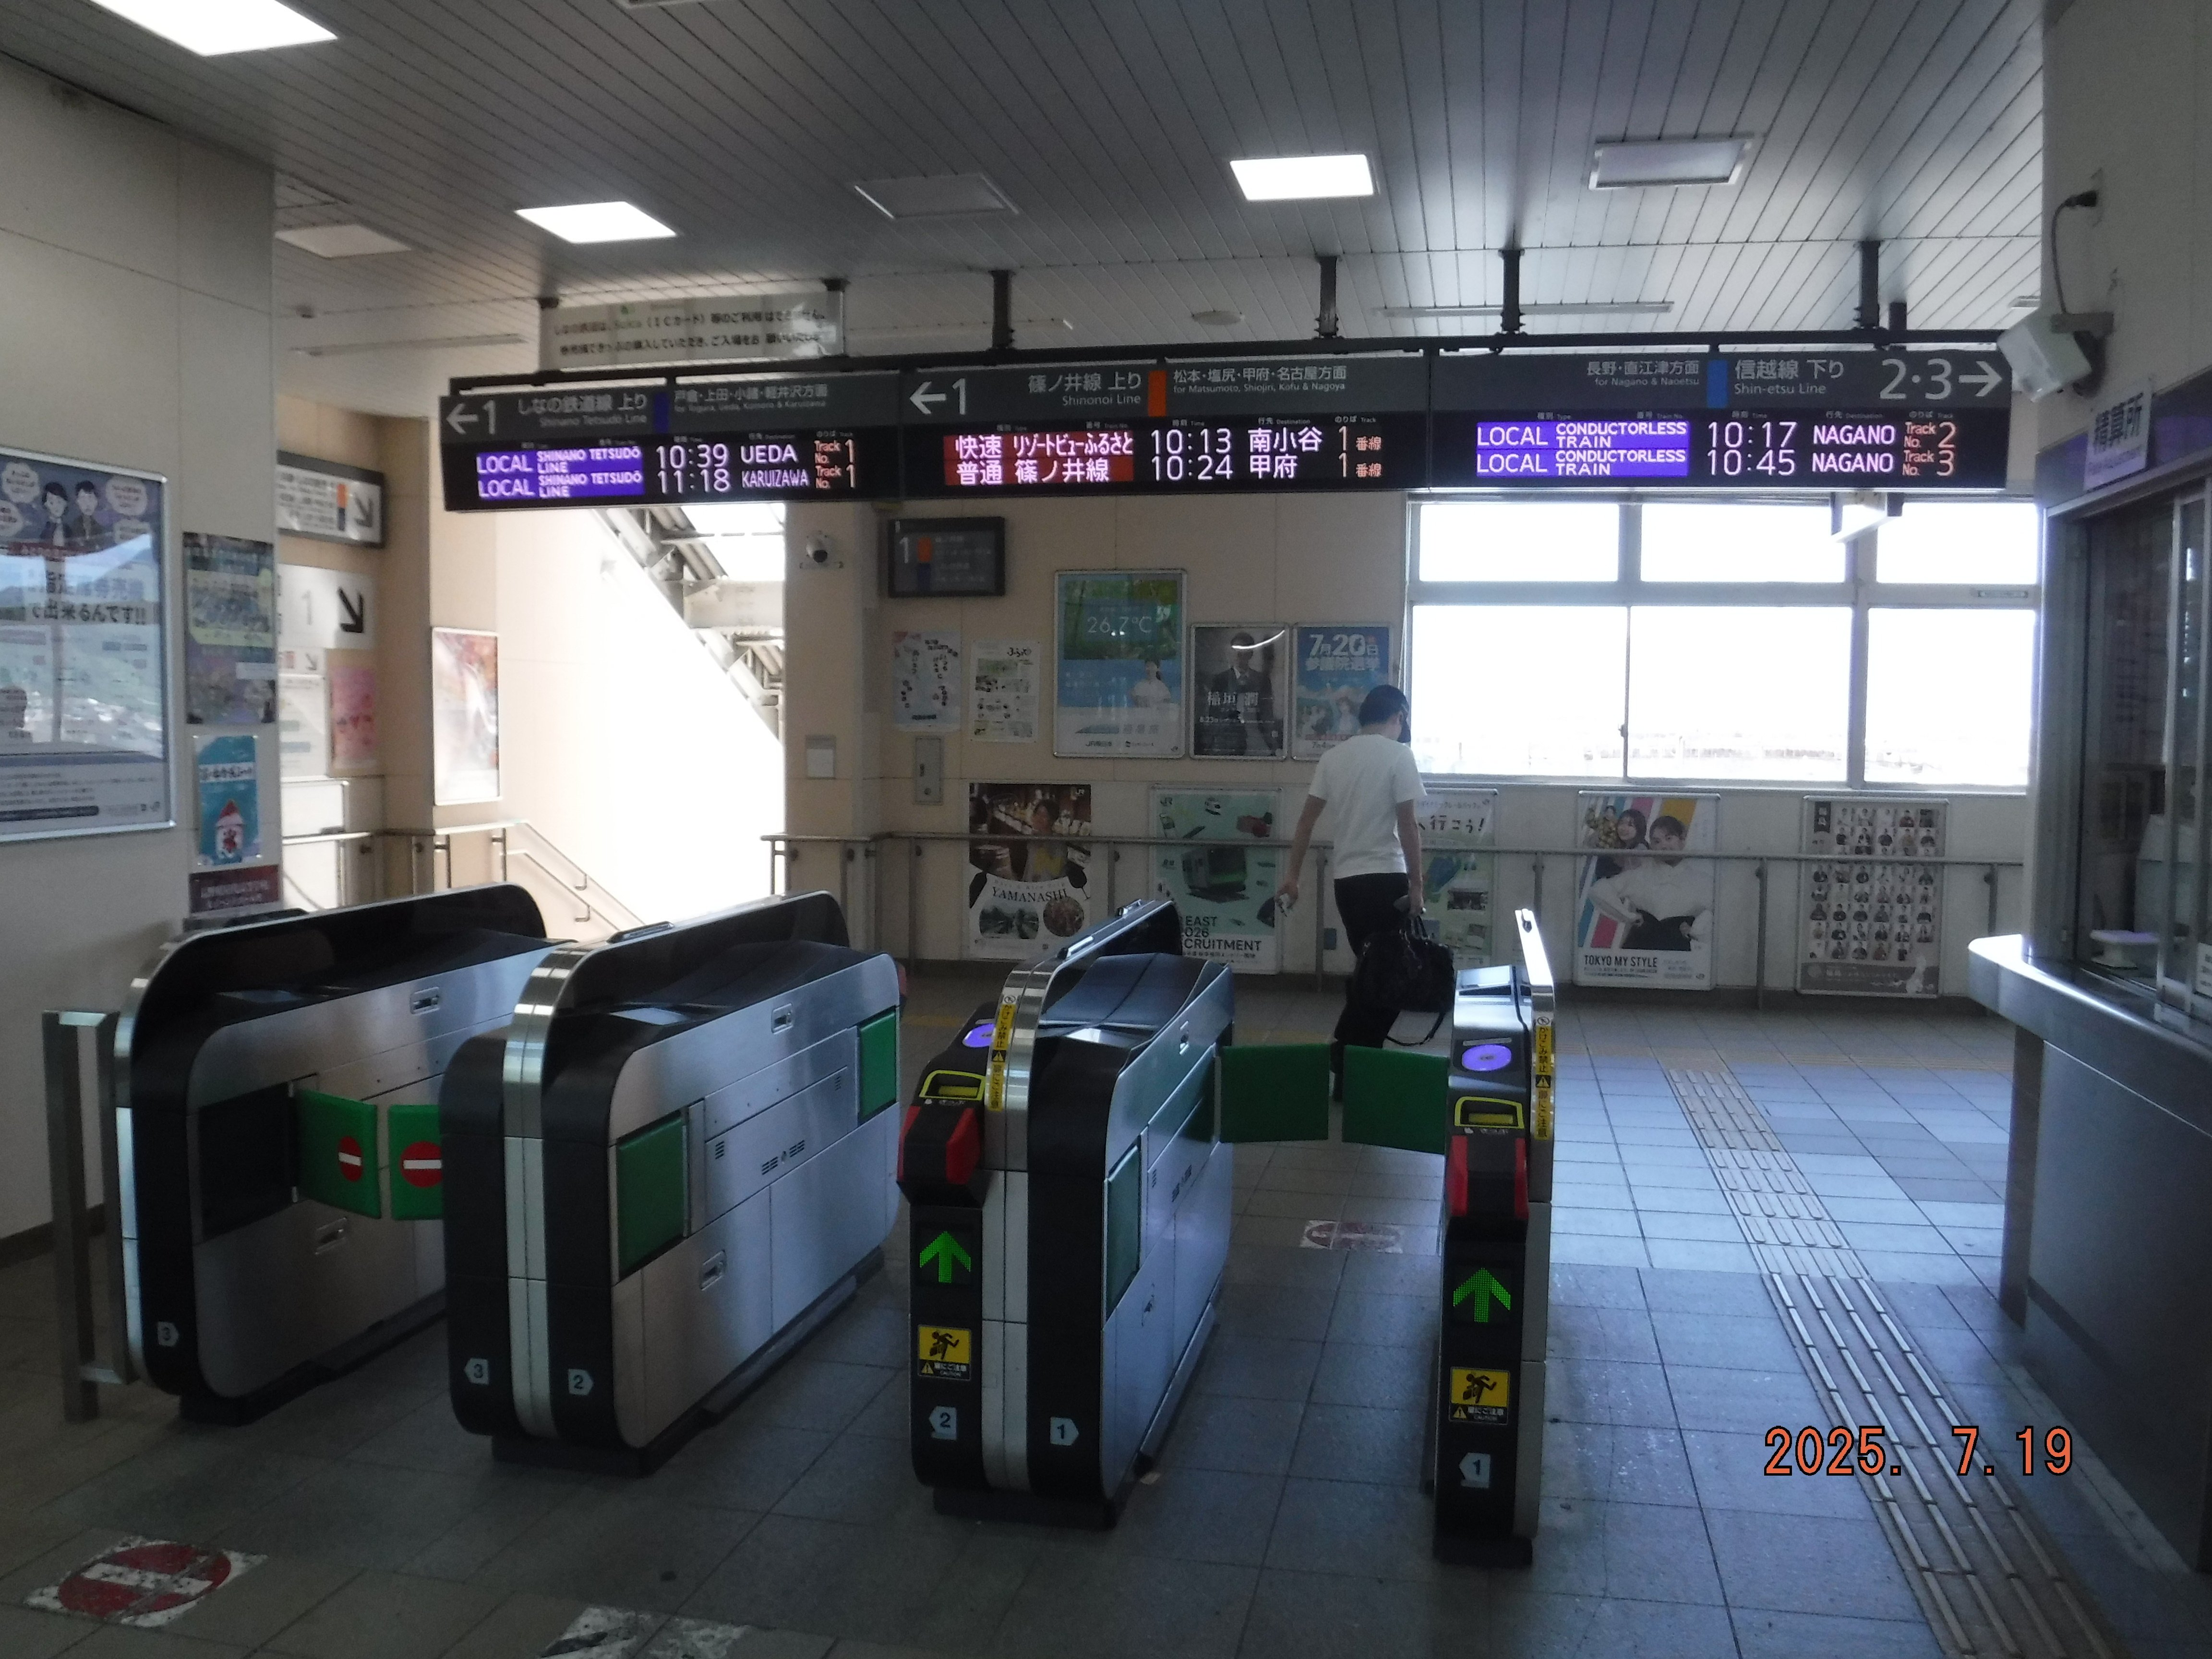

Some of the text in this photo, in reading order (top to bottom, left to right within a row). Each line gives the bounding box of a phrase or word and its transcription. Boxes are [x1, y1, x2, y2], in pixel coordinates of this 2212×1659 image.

[1734, 359, 1844, 380] 信越線 下り
[1028, 372, 1142, 394] 篠ノ井線 上り
[1173, 385, 1186, 394] for
[1189, 384, 1241, 394] Matsumoto,
[1279, 383, 1299, 392] Kofu
[1302, 383, 1309, 391] &
[1311, 382, 1346, 392] Nagoya
[1595, 377, 1609, 385] for
[1651, 377, 1658, 385] &
[1734, 383, 1827, 396] Shin-etsu Line
[618, 393, 647, 410] 上り
[952, 378, 966, 415] 1
[1062, 394, 1141, 407] Shinonoi Line
[482, 399, 496, 434] 1
[1477, 426, 1549, 447] LOCAL
[1556, 421, 1687, 436] CONDUCTORLESS
[1707, 421, 1798, 449] 10:17
[1813, 424, 1896, 445] NAGANO
[1905, 421, 1956, 449] Track 2
[955, 432, 1134, 459] 快速 リゾートビューふるさと
[1151, 429, 1232, 455] 10:13
[1248, 426, 1323, 453] 南小谷
[1356, 436, 1382, 451] 番線
[1556, 435, 1612, 448] TRAIN
[1904, 436, 1921, 448] No.
[536, 449, 587, 463] SHINANO
[656, 443, 729, 469] 10:39
[741, 444, 799, 464] UEDA
[815, 438, 856, 464] Track 1
[1555, 449, 1686, 463] CONDUCTORLESS
[476, 454, 534, 474] LOCAL
[537, 462, 568, 474] LINE
[956, 457, 1110, 486] 普通 篠ノ井線
[1152, 454, 1233, 481] 10:24
[1250, 454, 1298, 479] 甲府
[1356, 463, 1382, 478] 番線
[1476, 453, 1548, 474] LOCAL
[1556, 463, 1611, 476] TRAIN
[1707, 449, 1796, 477] 10:45
[1811, 452, 1895, 473] NAGANO
[1902, 463, 1920, 477] No.
[1904, 449, 1955, 477] Track 3
[538, 474, 588, 486] SHINANO
[658, 468, 731, 494] 11:18
[741, 469, 809, 489] KARUIZAWA
[815, 464, 856, 489] Track 1
[478, 478, 535, 499] LOCAL
[538, 486, 570, 499] LINE
[899, 537, 909, 564] 1
[301, 590, 314, 626] 1
[992, 886, 1068, 903] YAMANASHI
[1185, 915, 1218, 926] EAST
[1184, 926, 1209, 938] 026
[1184, 938, 1262, 951] CRUITMENT
[1585, 954, 1658, 968] TOKYO MY STYLE
[1539, 1026, 1549, 1073] かけこみ禁止
[573, 1374, 584, 1390] 2
[939, 1412, 951, 1428] 2
[1056, 1422, 1066, 1441] 1
[1472, 1459, 1481, 1476] 1
